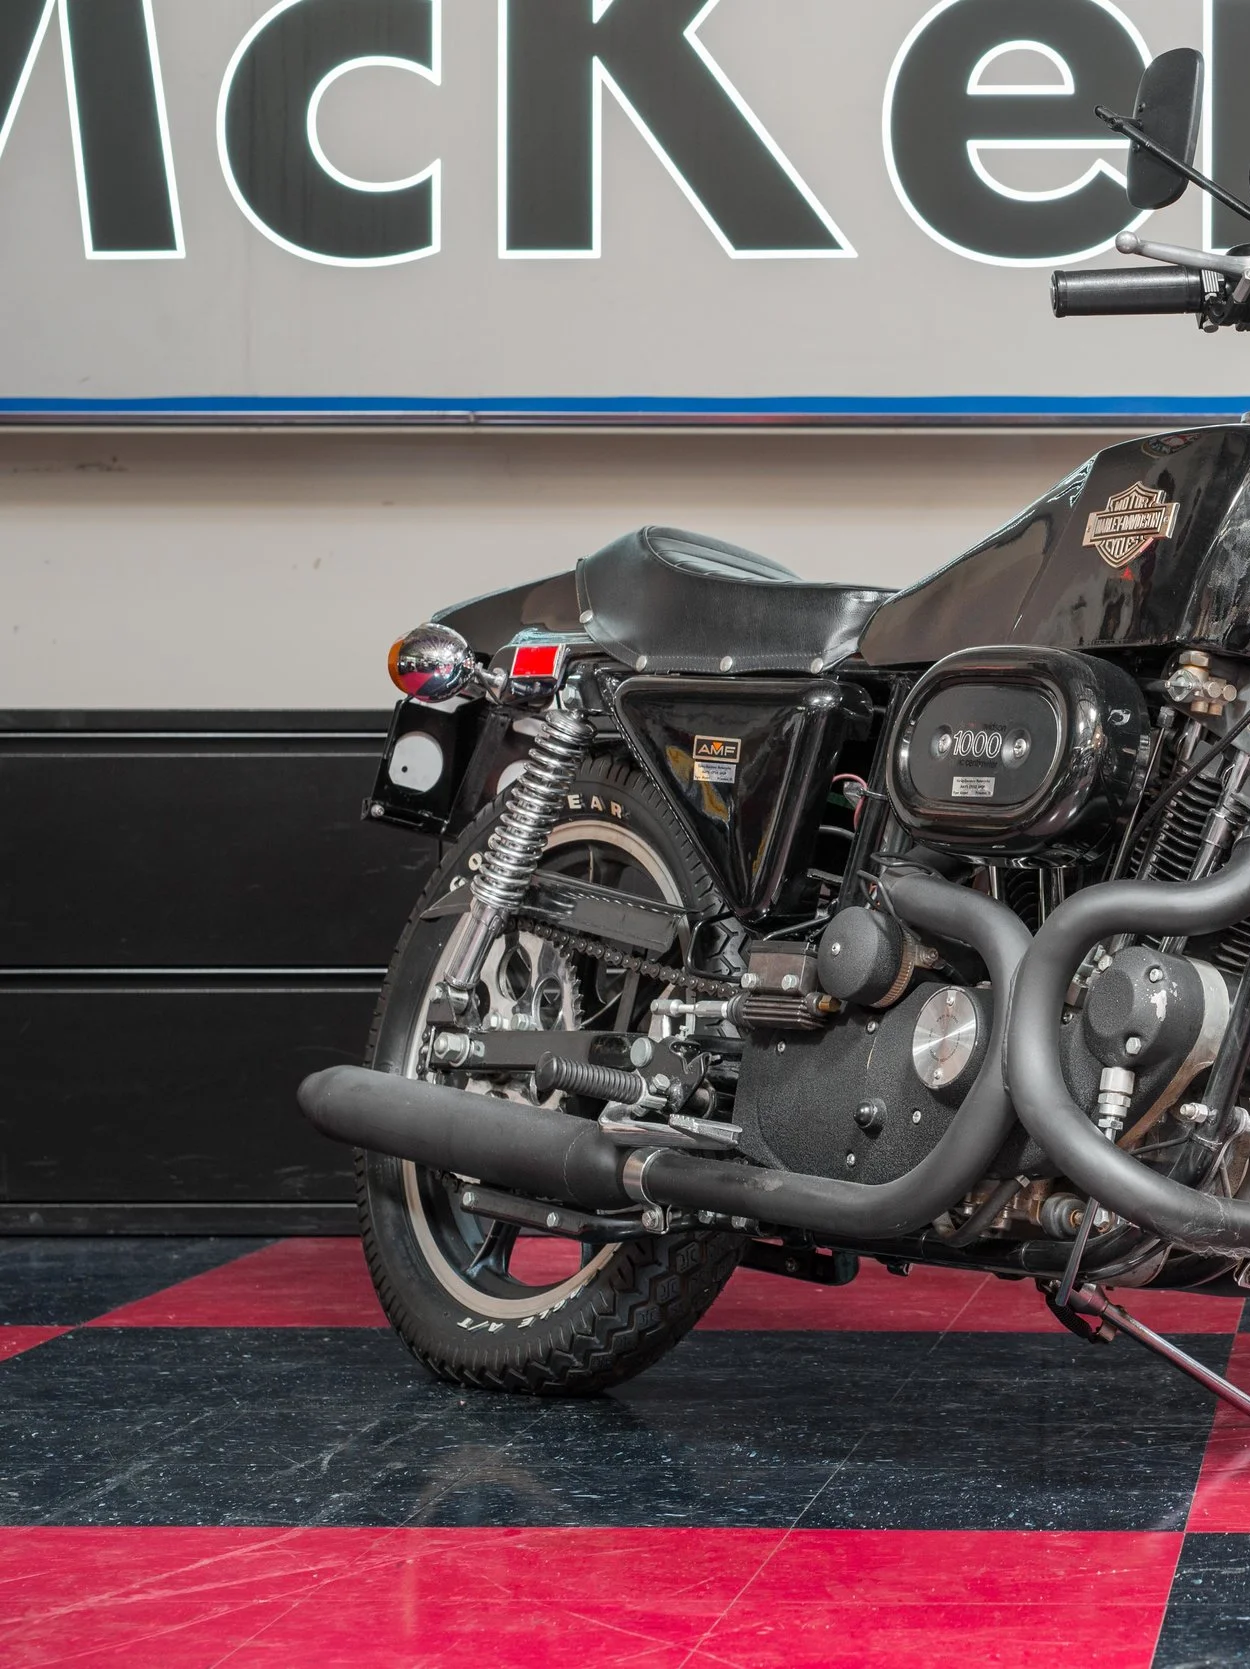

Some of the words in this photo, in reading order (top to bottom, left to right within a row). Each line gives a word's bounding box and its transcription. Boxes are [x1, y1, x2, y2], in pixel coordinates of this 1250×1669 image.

[1114, 491, 1153, 511] MOTOR
[1095, 510, 1162, 534] HARLEY-DAVIDSON
[1104, 535, 1144, 558] CYCLES
[698, 743, 736, 756] AMF
[952, 730, 1002, 758] 1000
